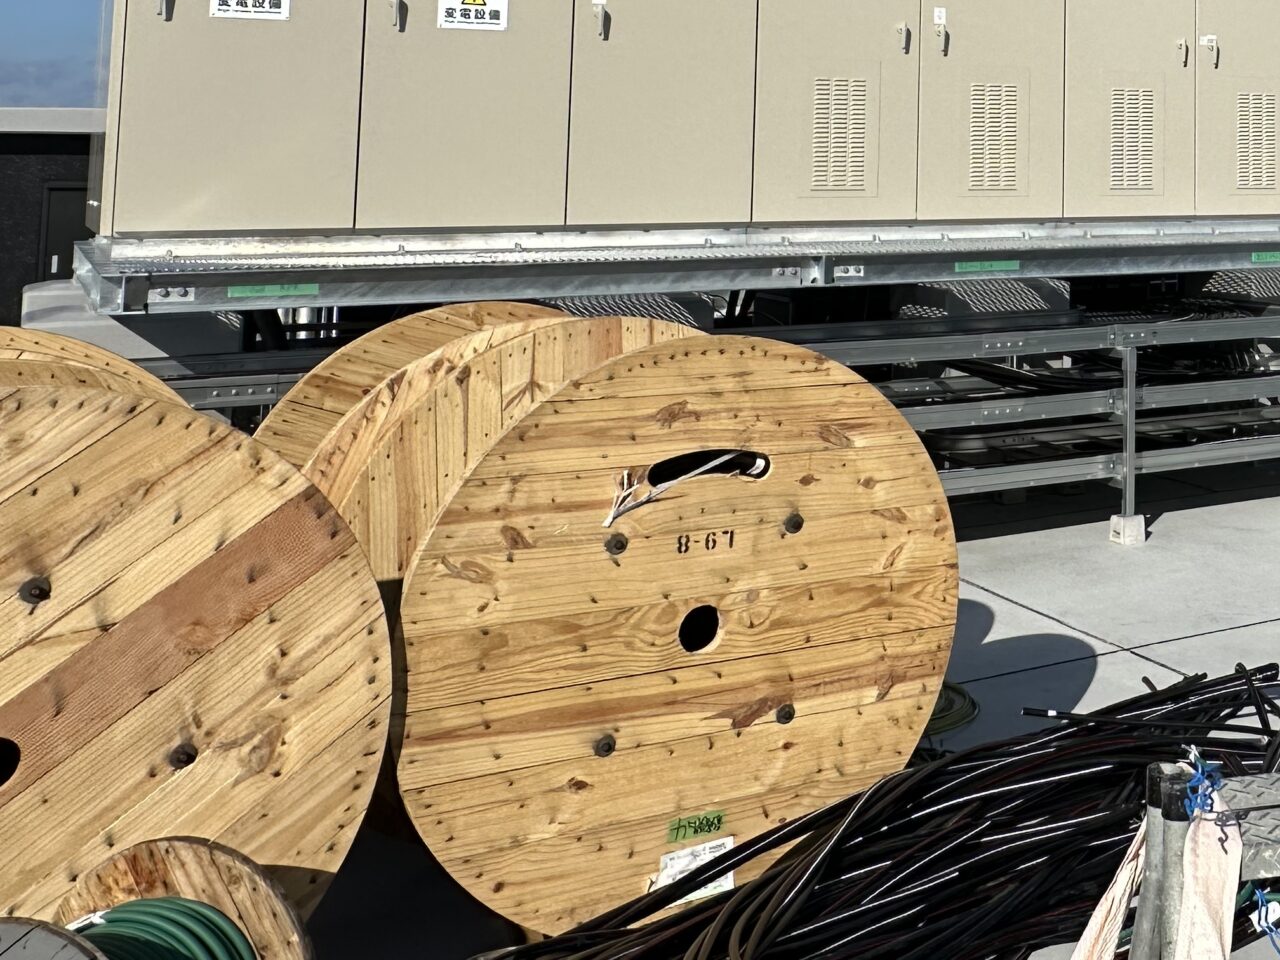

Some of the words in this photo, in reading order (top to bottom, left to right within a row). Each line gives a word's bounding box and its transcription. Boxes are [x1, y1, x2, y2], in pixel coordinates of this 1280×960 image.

[444, 7, 501, 20] 変電設備
[677, 530, 735, 553] 8-67
